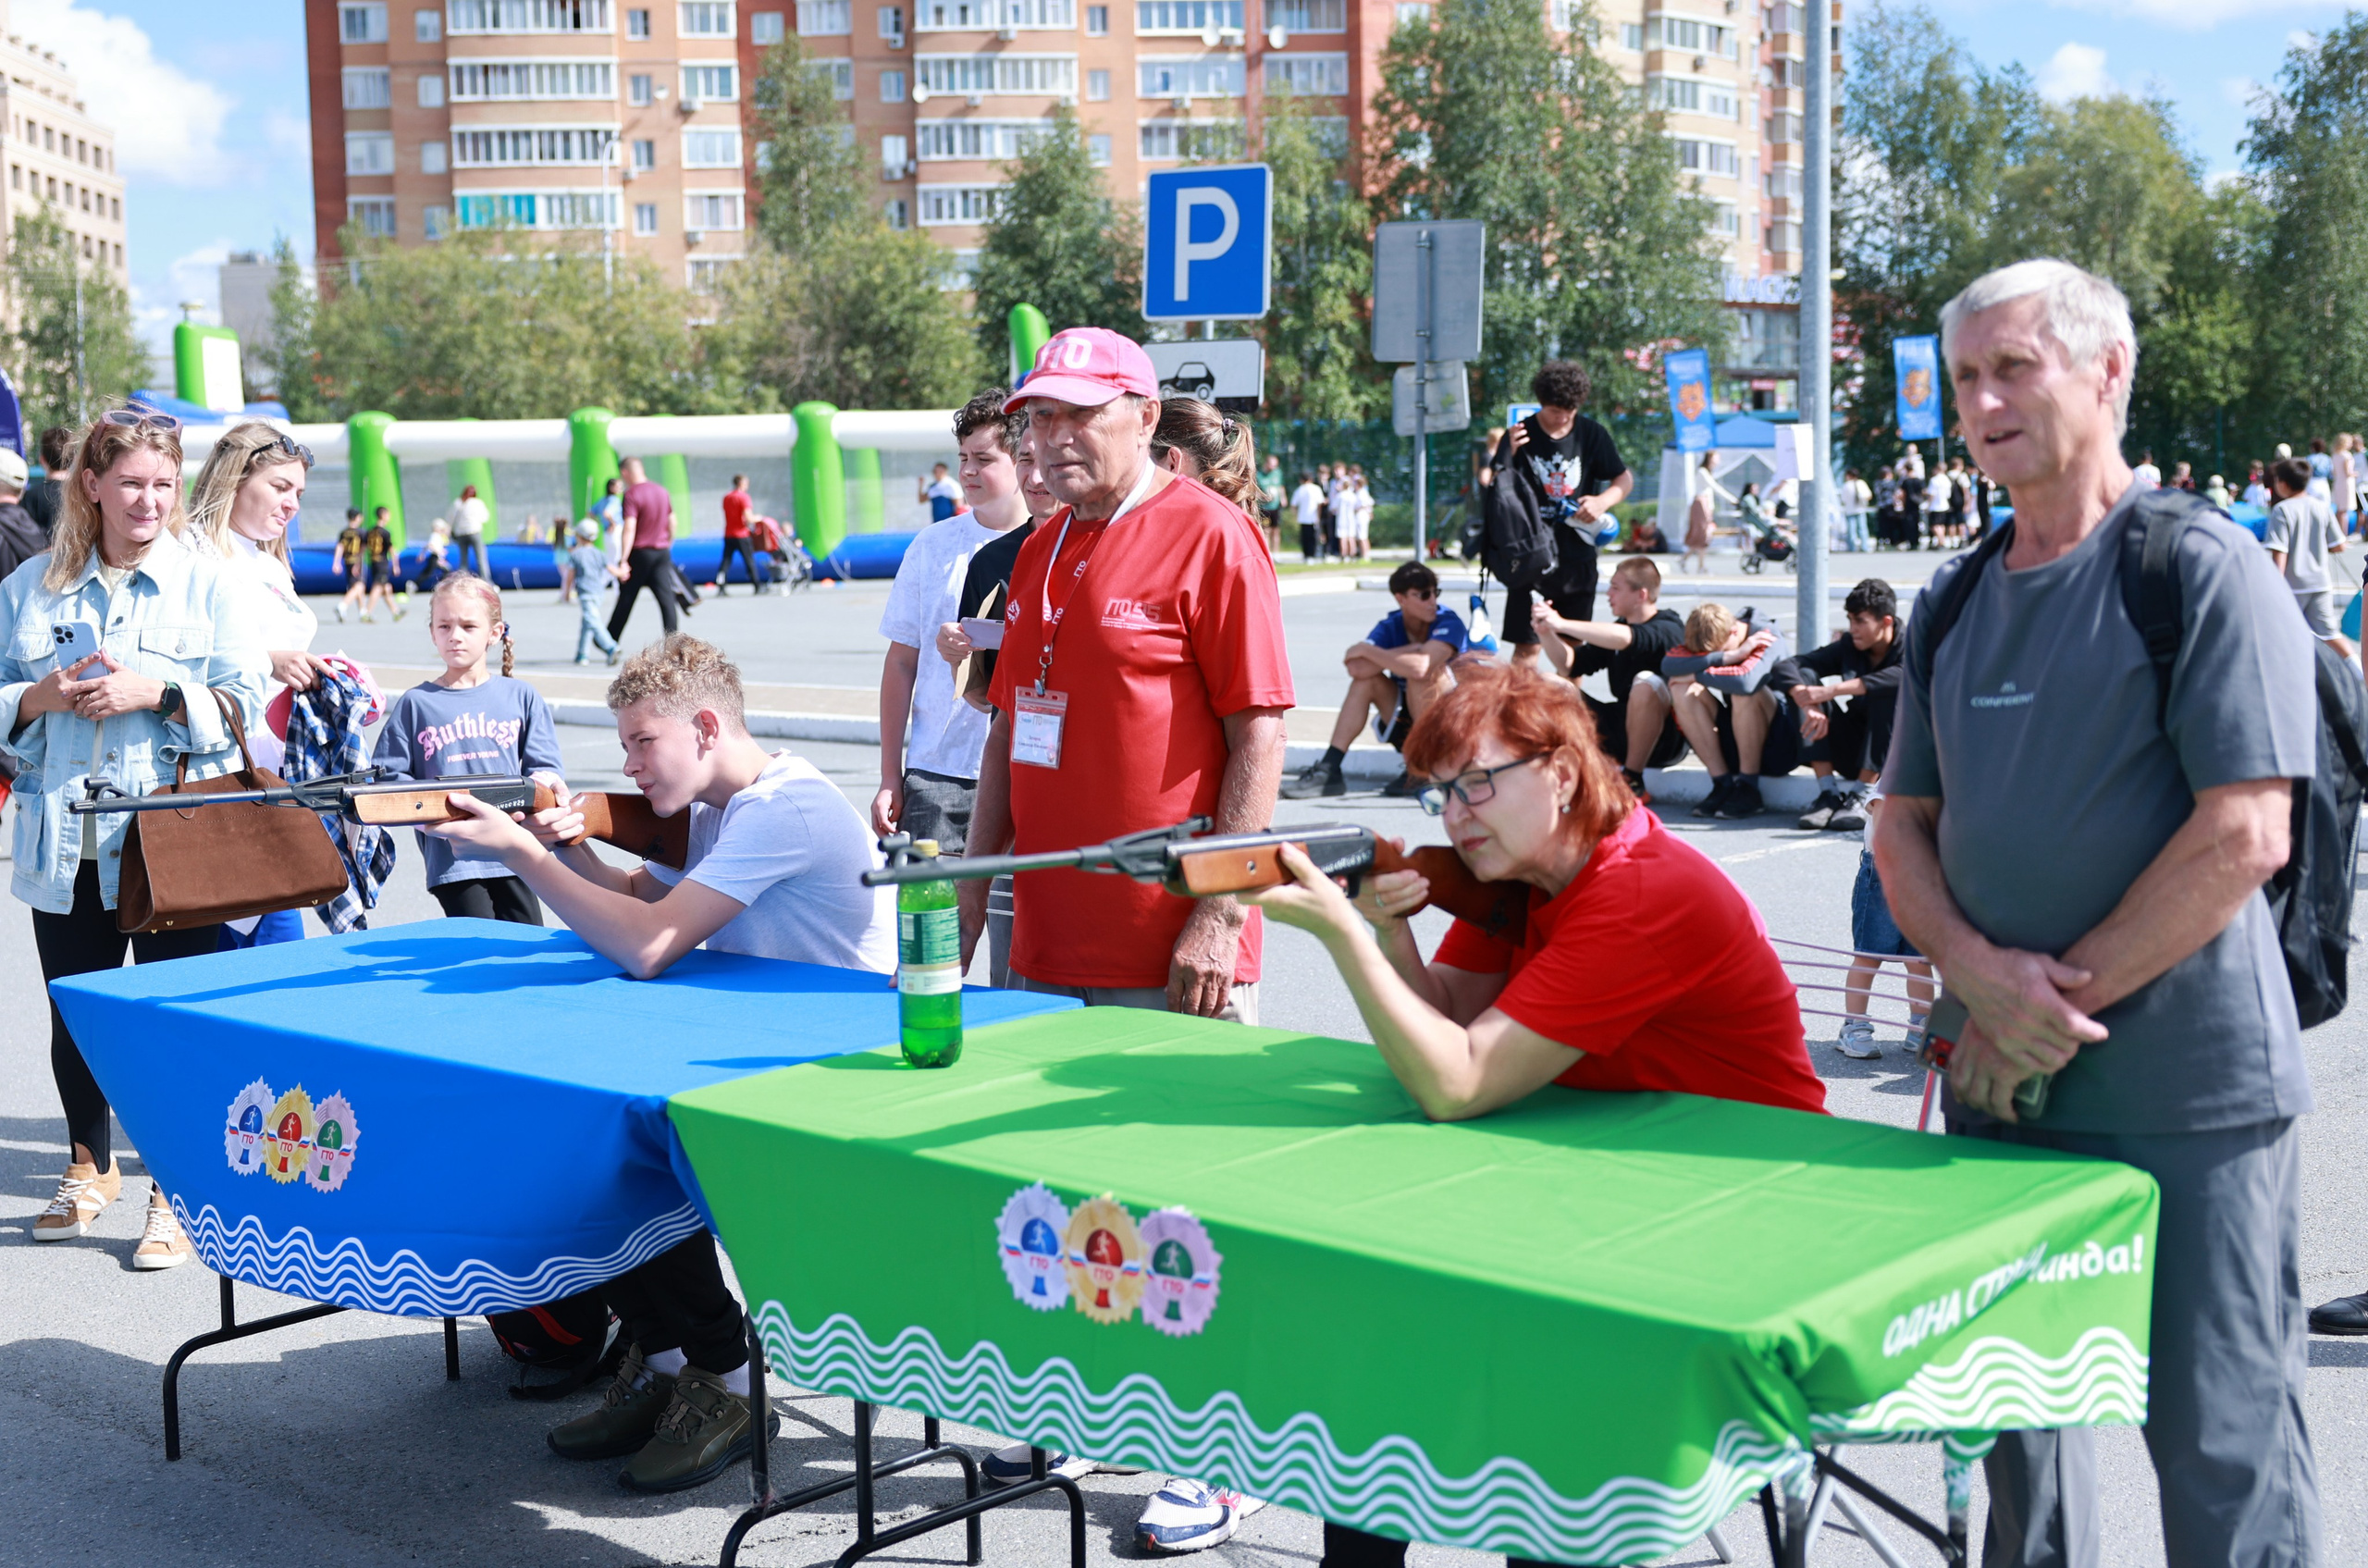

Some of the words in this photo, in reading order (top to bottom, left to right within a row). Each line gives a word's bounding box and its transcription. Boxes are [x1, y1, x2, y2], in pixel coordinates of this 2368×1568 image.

[1174, 186, 1240, 302] P
[1073, 560, 1087, 577] ГТО
[1051, 607, 1064, 625] ГТО
[417, 711, 521, 760] Ruthless
[447, 751, 476, 763] FOREVER
[477, 750, 500, 759] YOUNG
[241, 1134, 254, 1145] ГТО
[279, 1142, 293, 1153] ГТО
[320, 1150, 335, 1161] ГТО
[1030, 1255, 1049, 1269] ГТО
[1093, 1267, 1114, 1281] ГТО
[1162, 1278, 1184, 1293] ГТО
[1882, 1289, 1961, 1357] ОДНА
